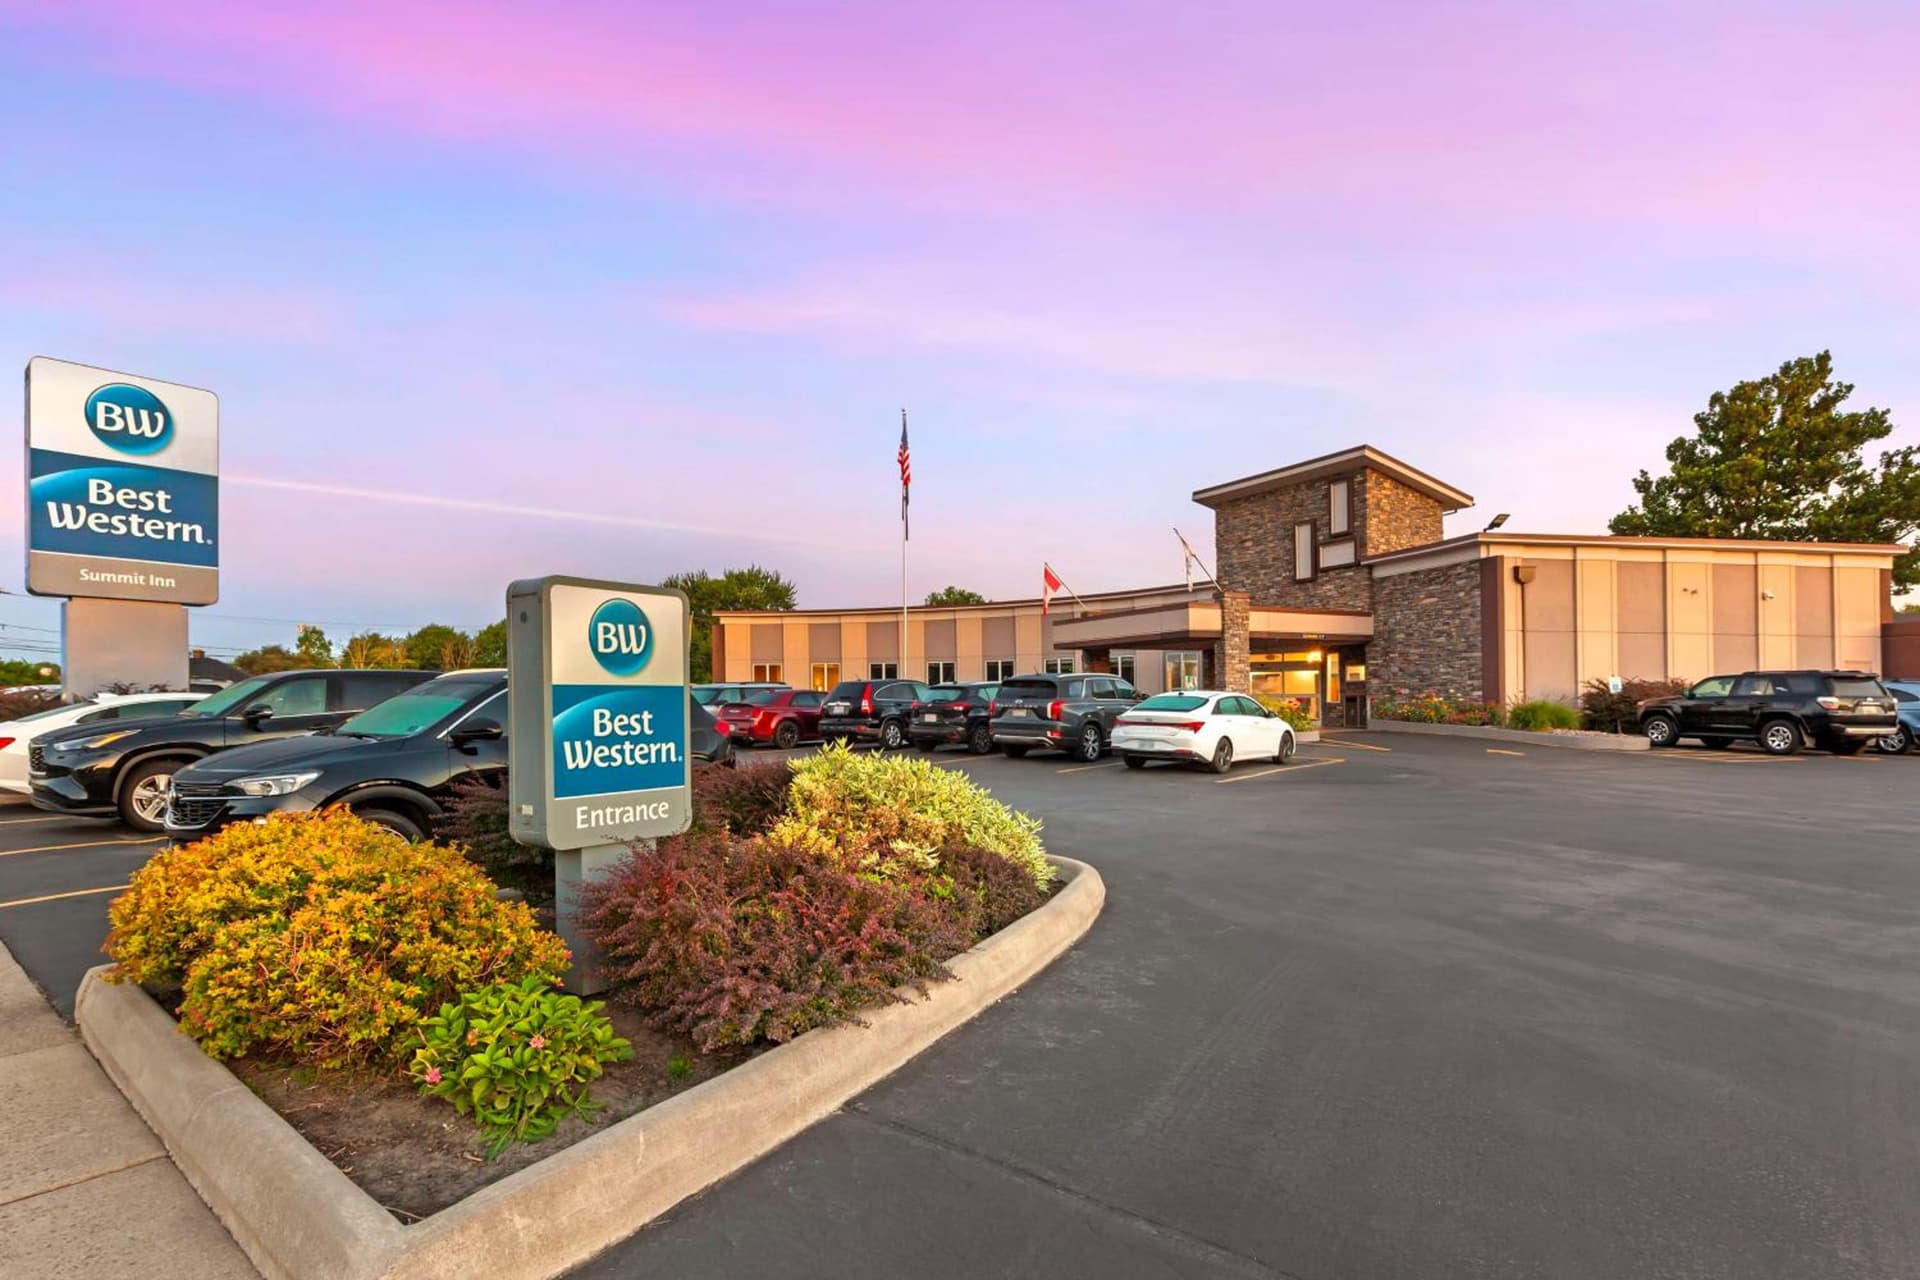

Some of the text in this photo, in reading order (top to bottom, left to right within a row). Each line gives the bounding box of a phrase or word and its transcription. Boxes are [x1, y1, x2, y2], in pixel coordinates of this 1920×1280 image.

[96, 401, 164, 438] BW
[88, 478, 172, 513] Best
[79, 568, 176, 588] Summit Inn
[597, 622, 646, 654] BW
[593, 708, 653, 737] Best
[576, 801, 670, 829] Entrance
